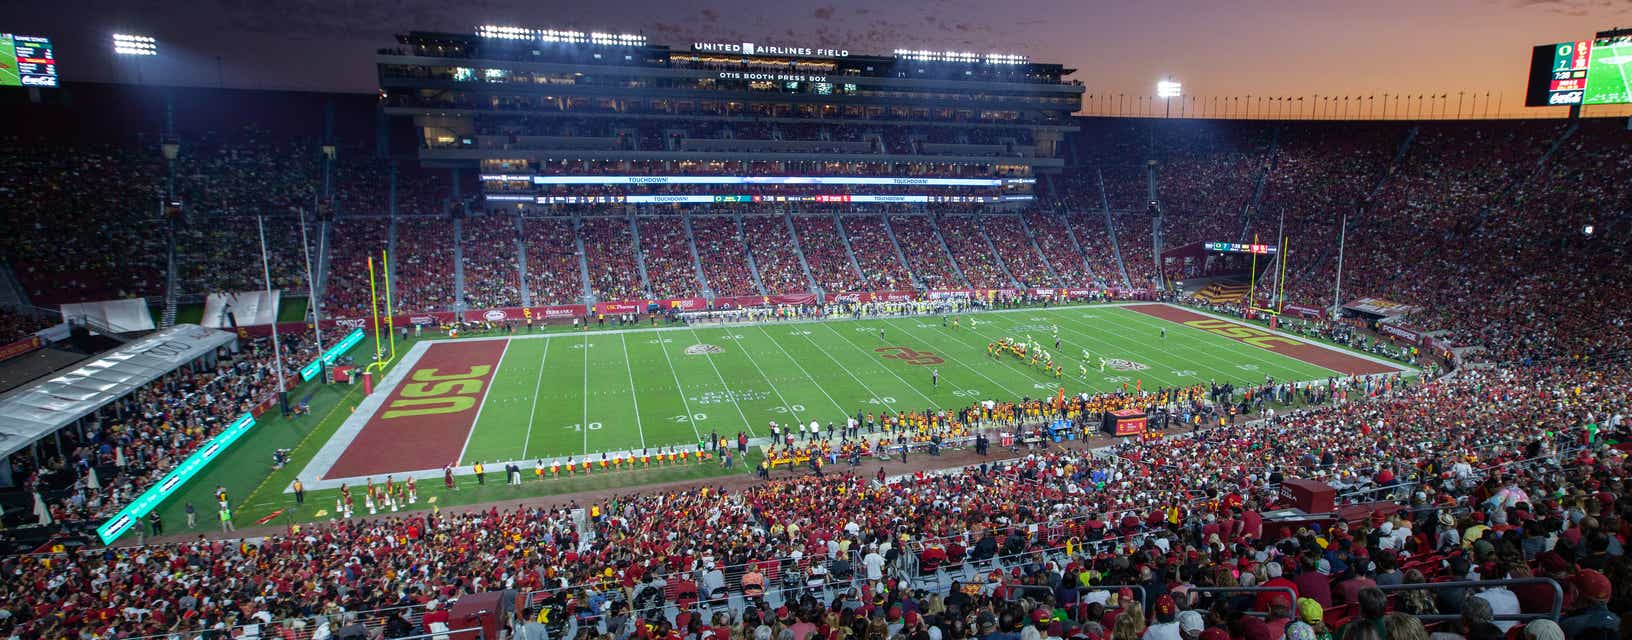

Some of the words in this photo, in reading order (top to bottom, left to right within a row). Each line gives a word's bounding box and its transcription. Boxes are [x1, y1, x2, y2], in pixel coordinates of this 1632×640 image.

[694, 42, 741, 52] UNITED
[757, 46, 812, 55] AIRLINES
[817, 48, 849, 57] FIELD
[1183, 319, 1304, 348] USC
[381, 364, 492, 419] USC
